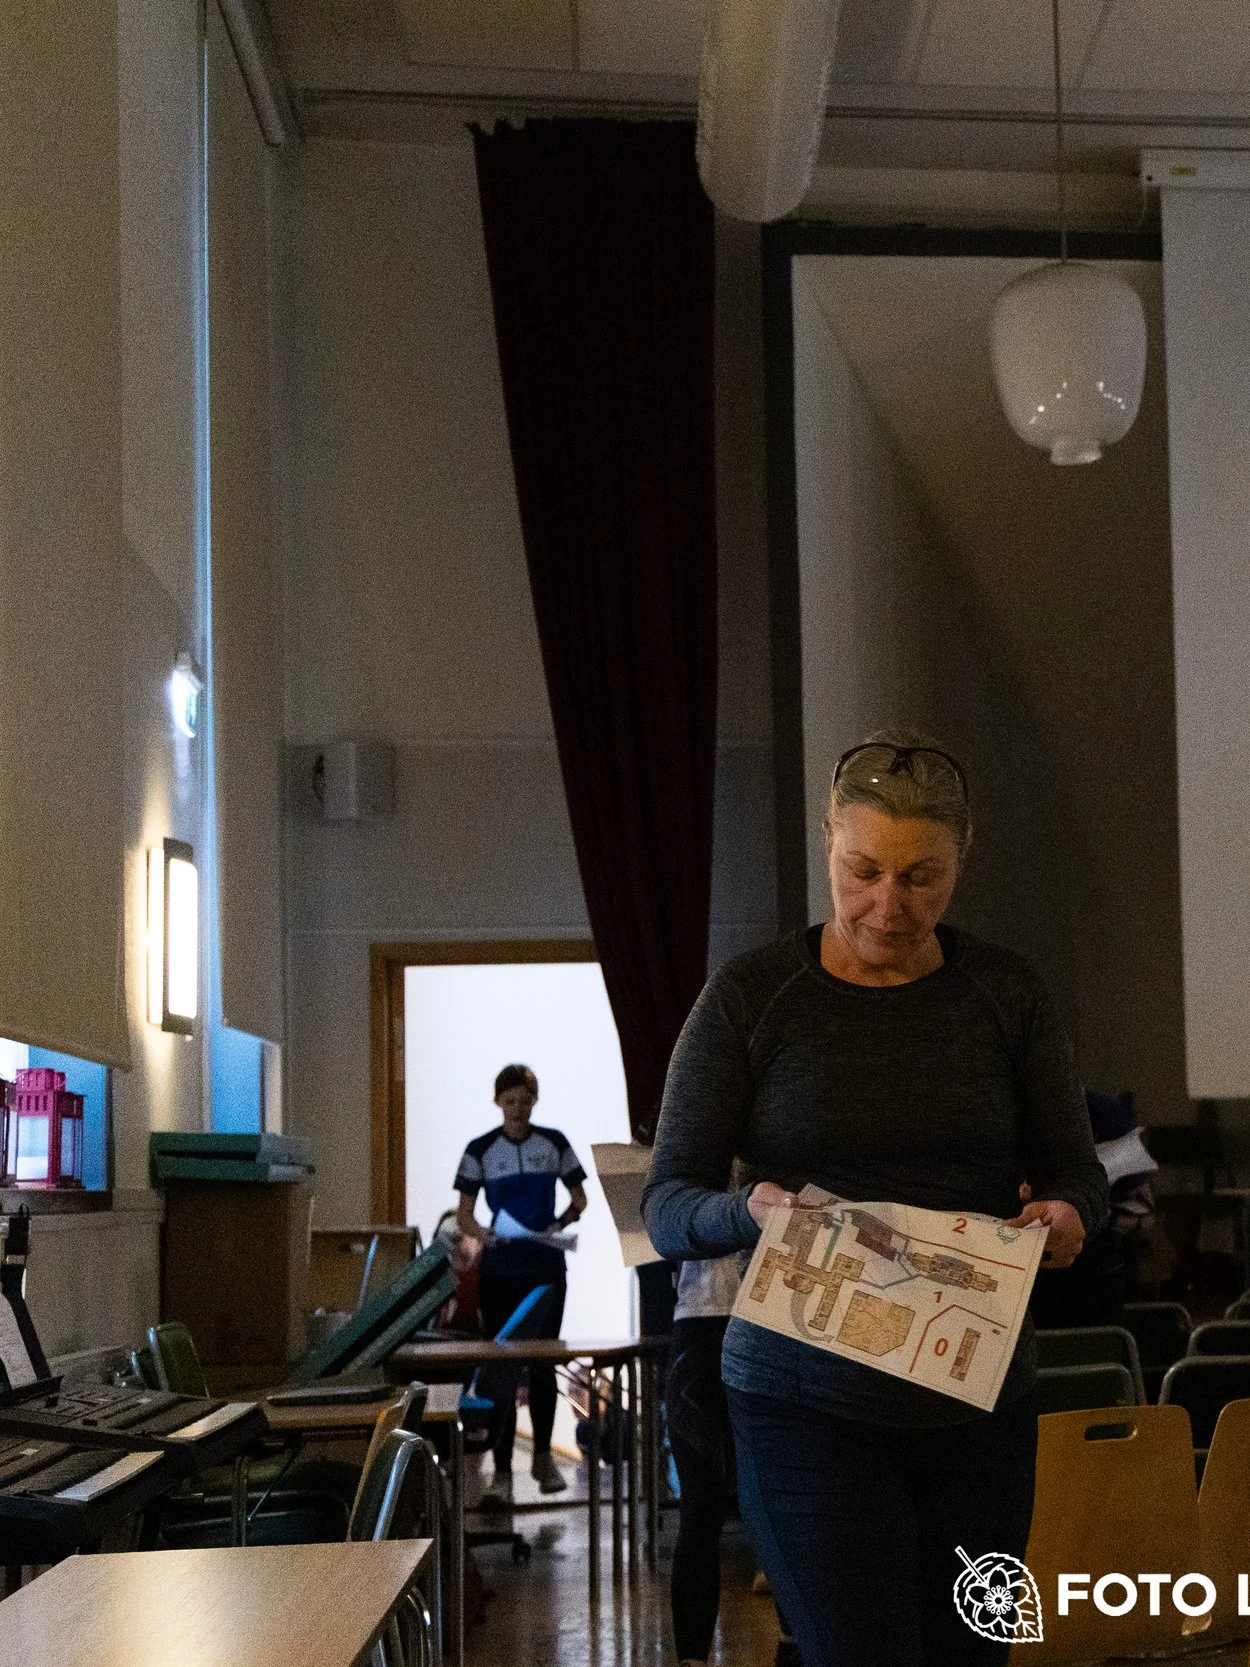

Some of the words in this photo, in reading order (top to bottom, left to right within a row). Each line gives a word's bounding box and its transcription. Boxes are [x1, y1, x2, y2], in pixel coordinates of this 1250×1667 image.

[953, 1217, 968, 1235] 2
[933, 1290, 943, 1304] 1
[934, 1337, 949, 1357] 0
